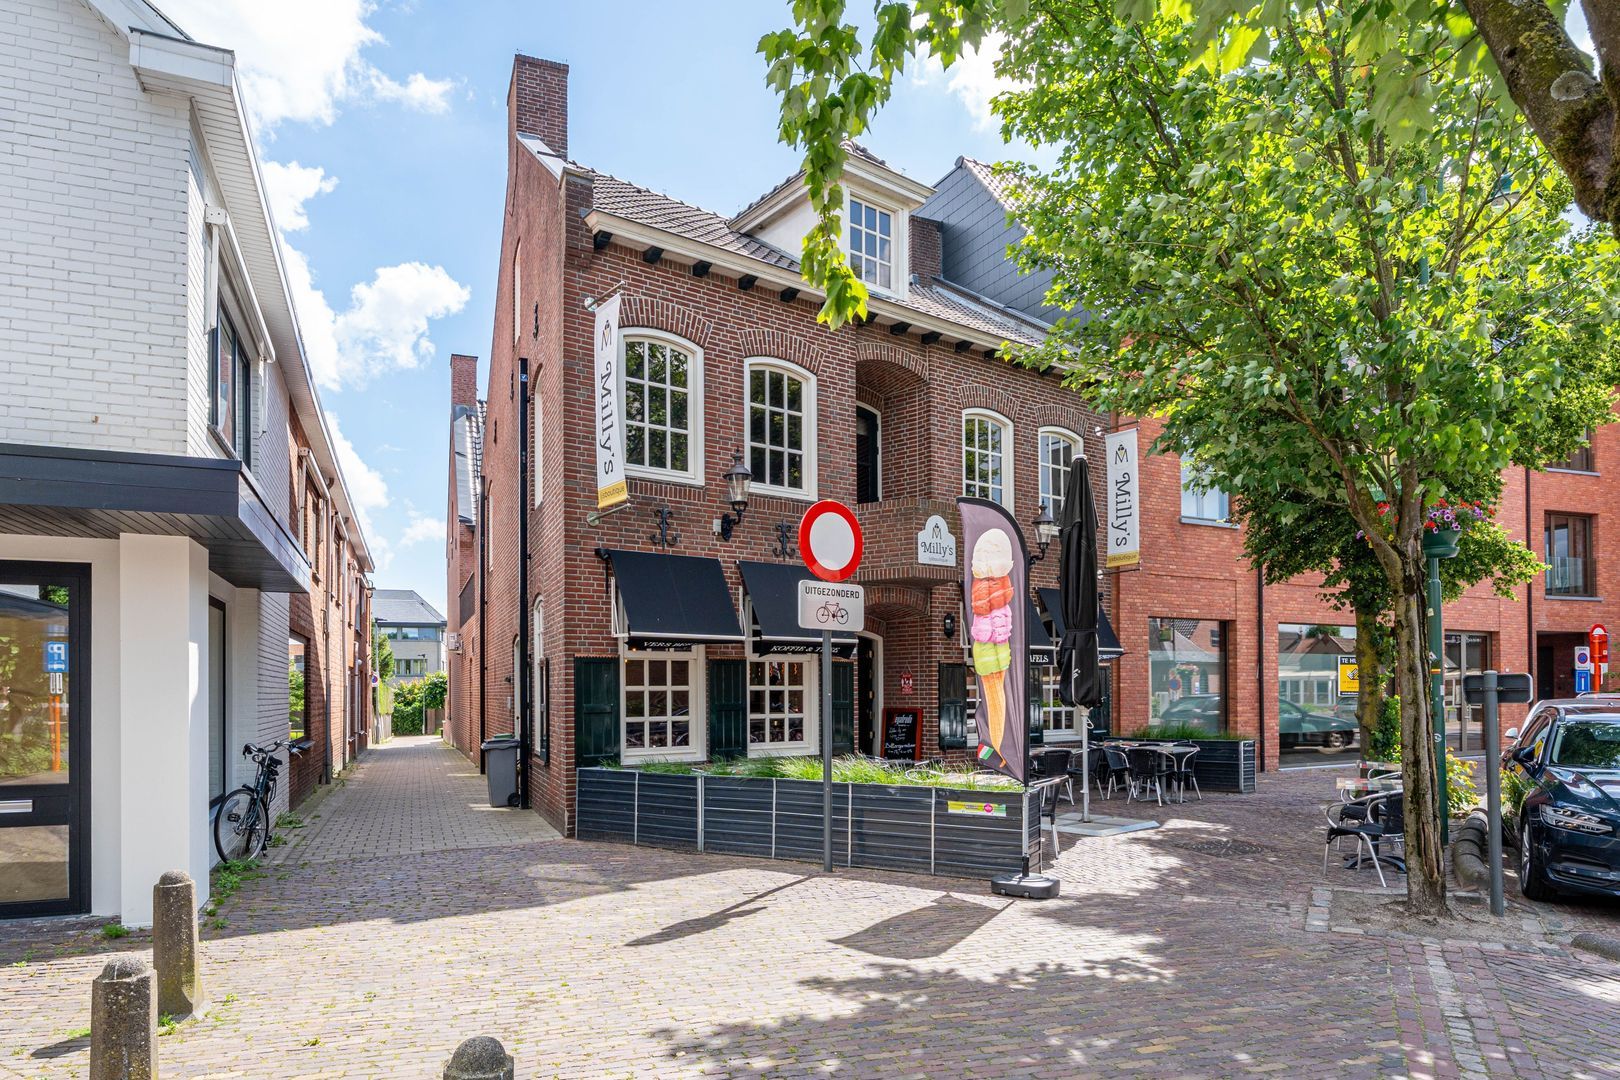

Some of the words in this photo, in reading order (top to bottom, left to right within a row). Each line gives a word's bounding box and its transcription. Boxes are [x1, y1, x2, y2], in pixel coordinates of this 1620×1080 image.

[600, 361, 615, 475] Milly's
[1111, 472, 1132, 547] Milly's
[920, 541, 954, 558] Milly's
[805, 586, 860, 599] UITGEZONDERD
